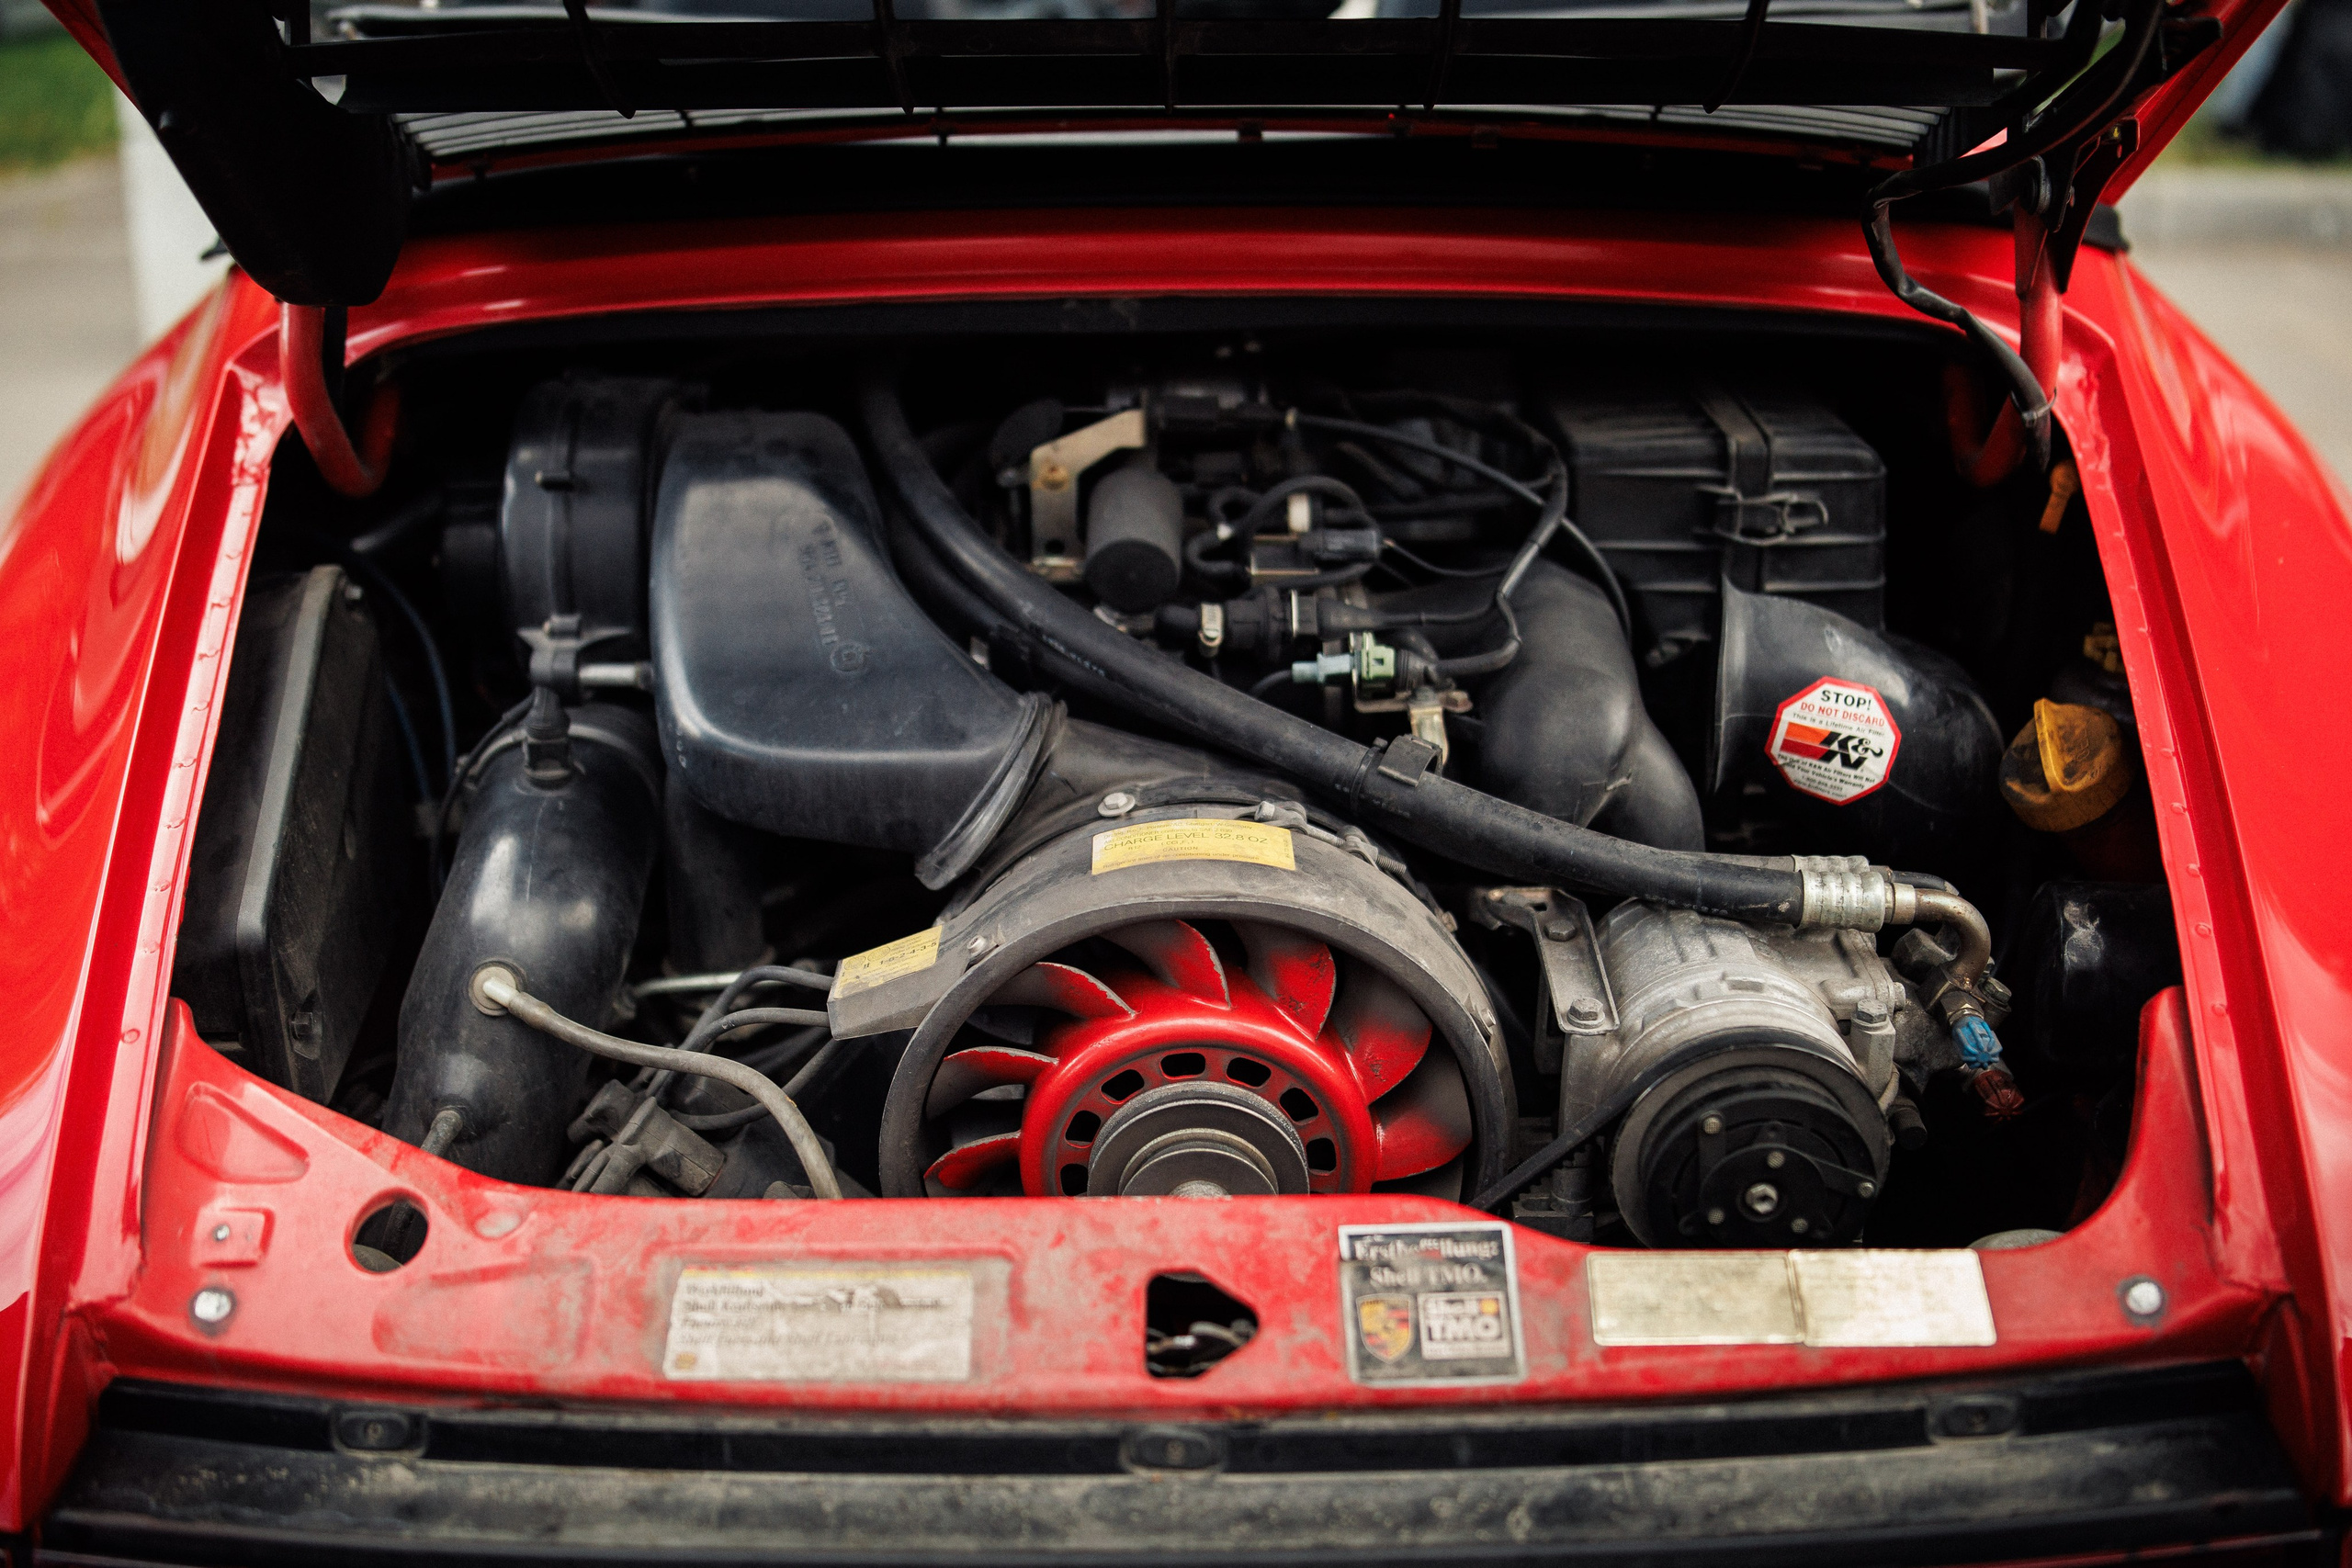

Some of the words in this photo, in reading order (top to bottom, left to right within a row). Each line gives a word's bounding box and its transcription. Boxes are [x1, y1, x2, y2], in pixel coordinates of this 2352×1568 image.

[1821, 690, 1871, 710] STOP!
[1792, 713, 1807, 721] This
[1826, 720, 1853, 732] Lifetime
[1869, 728, 1884, 737] Filter
[1801, 702, 1815, 713] DO
[1817, 705, 1838, 717] NOT
[1842, 710, 1884, 727] DISCARD
[1797, 764, 1810, 773] Your
[1811, 769, 1838, 782] Vehicle's
[1839, 777, 1864, 789] Warranty
[1809, 761, 1822, 771] K&N
[1833, 768, 1851, 778] Filters
[1853, 773, 1864, 781] Will
[1103, 834, 1163, 852] CHARGE
[1248, 836, 1269, 844] OZ
[1370, 1265, 1423, 1286] Shell
[1427, 1316, 1501, 1341] TMO
